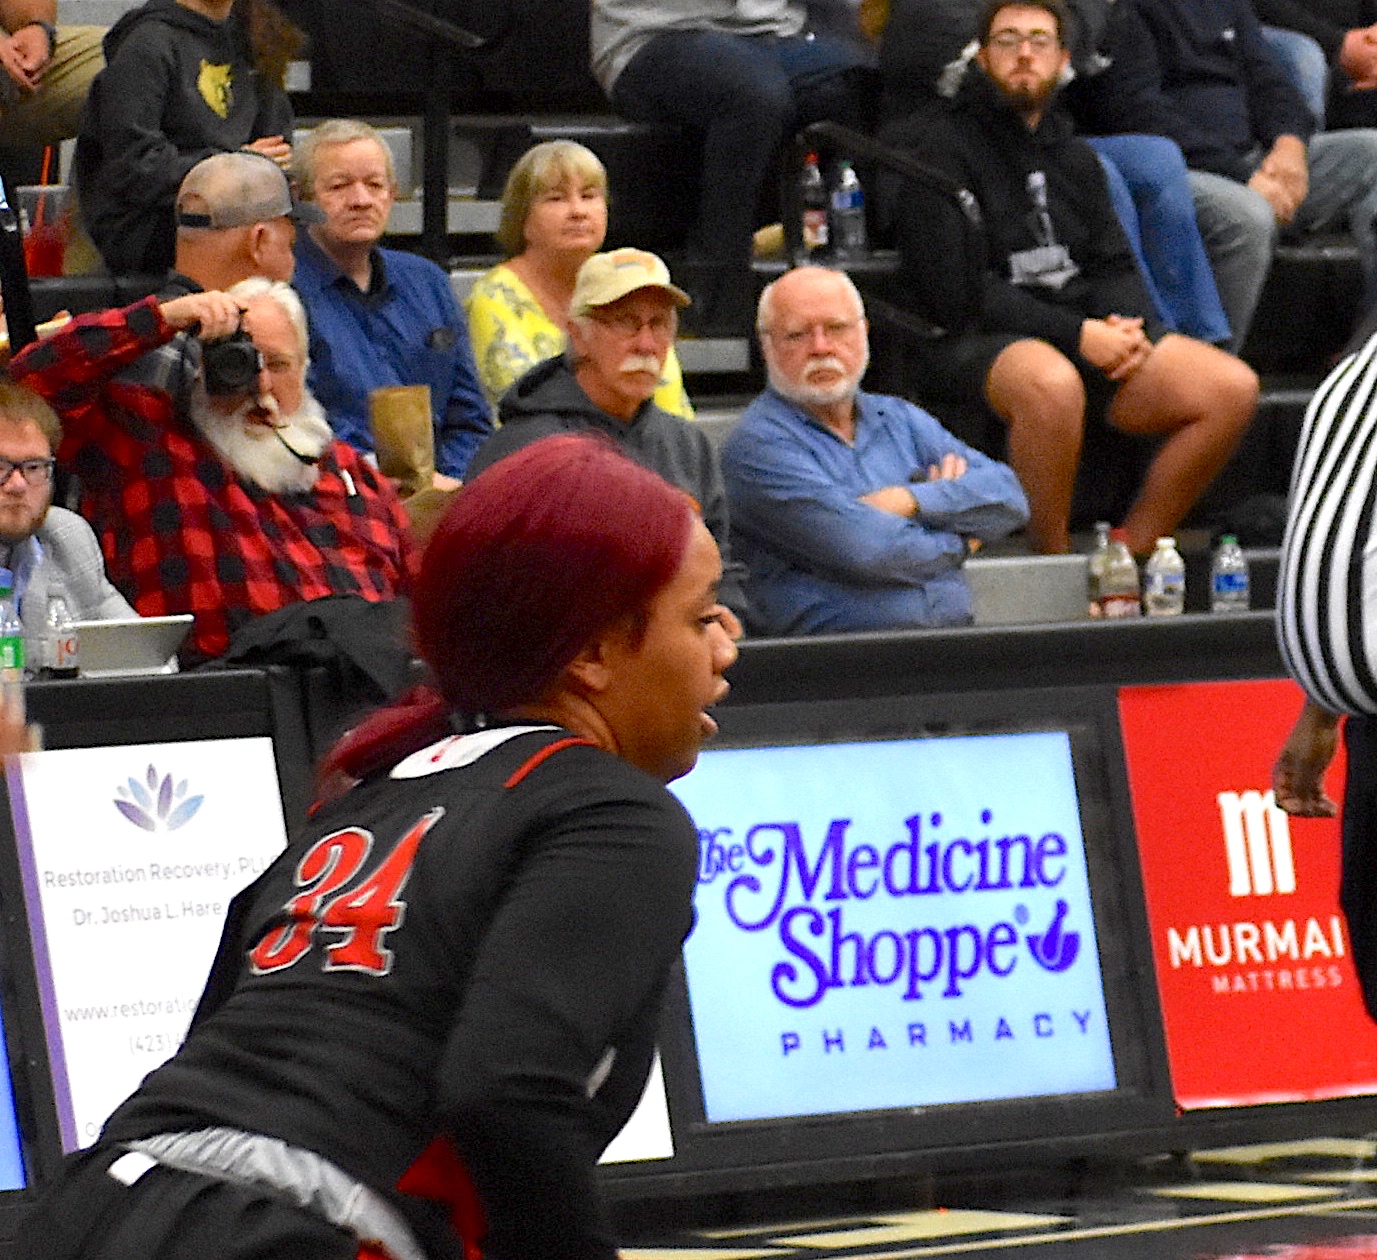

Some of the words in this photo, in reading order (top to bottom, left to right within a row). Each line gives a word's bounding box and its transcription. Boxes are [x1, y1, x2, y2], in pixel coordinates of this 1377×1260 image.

[44, 865, 147, 888] Restoration
[697, 827, 745, 884] The
[724, 809, 1068, 931] Medicine
[249, 806, 446, 977] 34
[72, 908, 98, 926] Dr.
[101, 904, 162, 924] Joshua
[1211, 965, 1343, 993] MATTRESS
[129, 1033, 171, 1055] (423)
[781, 1010, 1091, 1056] PHARMACY
